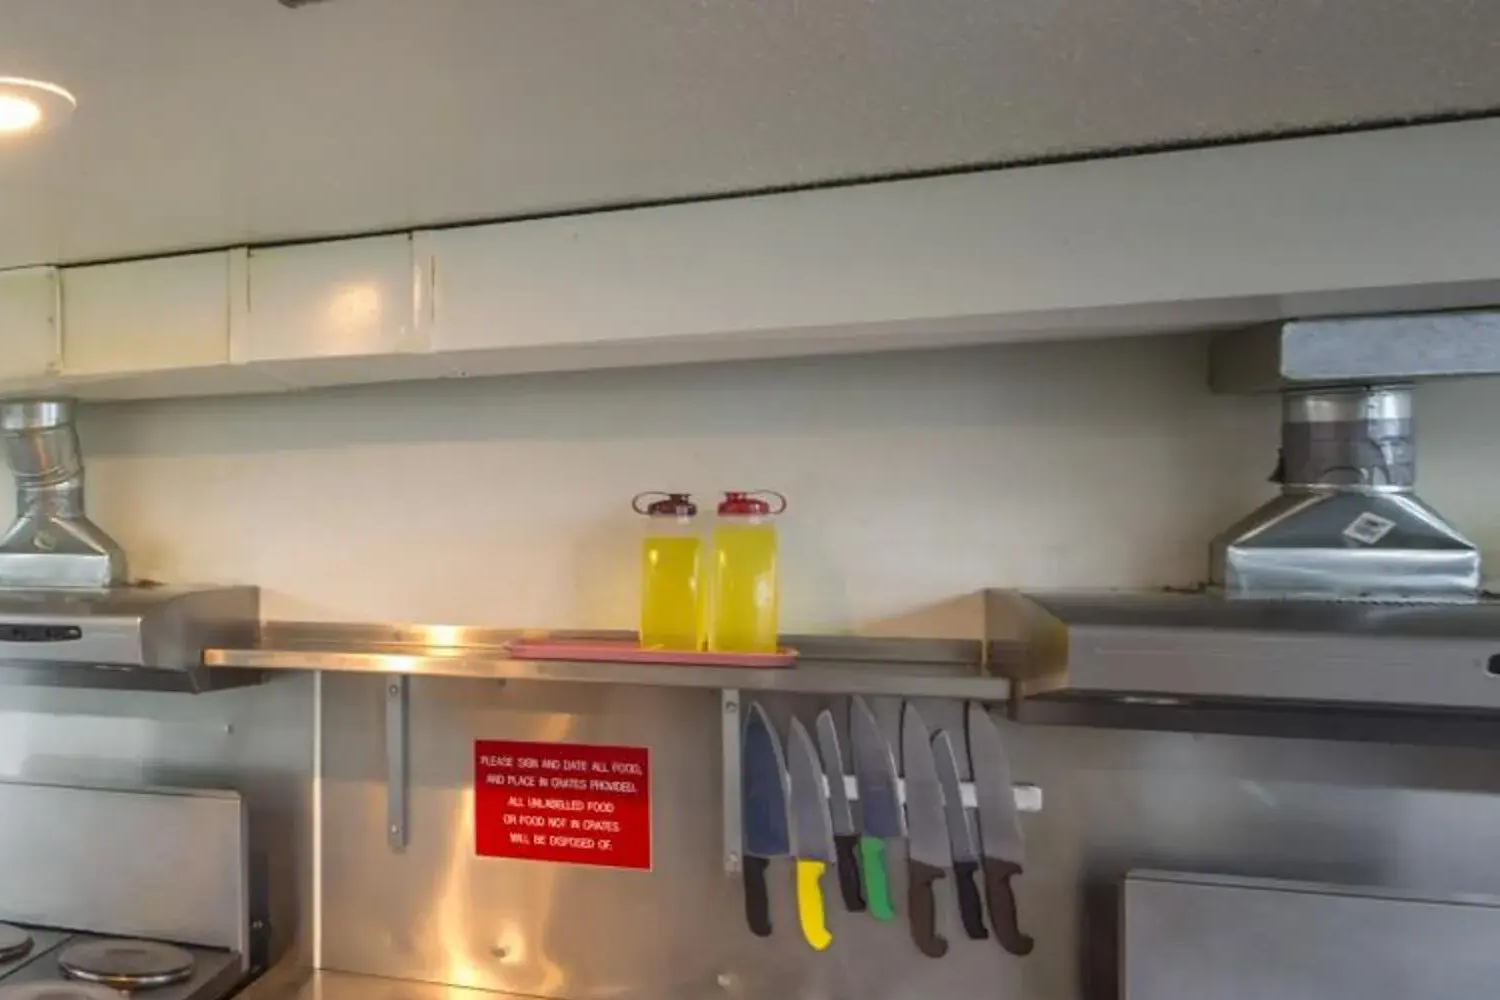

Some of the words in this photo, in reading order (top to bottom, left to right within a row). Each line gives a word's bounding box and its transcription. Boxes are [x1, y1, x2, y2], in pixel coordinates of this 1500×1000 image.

[480, 755, 513, 767] PLEASE
[563, 759, 587, 771] DATE
[591, 761, 610, 773] ALL
[507, 775, 536, 787] PLACE
[507, 796, 525, 808] ALL
[587, 801, 615, 813] FOOD
[503, 814, 517, 825] OR
[519, 815, 545, 827] FOOD
[547, 817, 567, 829] NOT
[509, 832, 531, 845] WILL
[533, 834, 546, 845] BE
